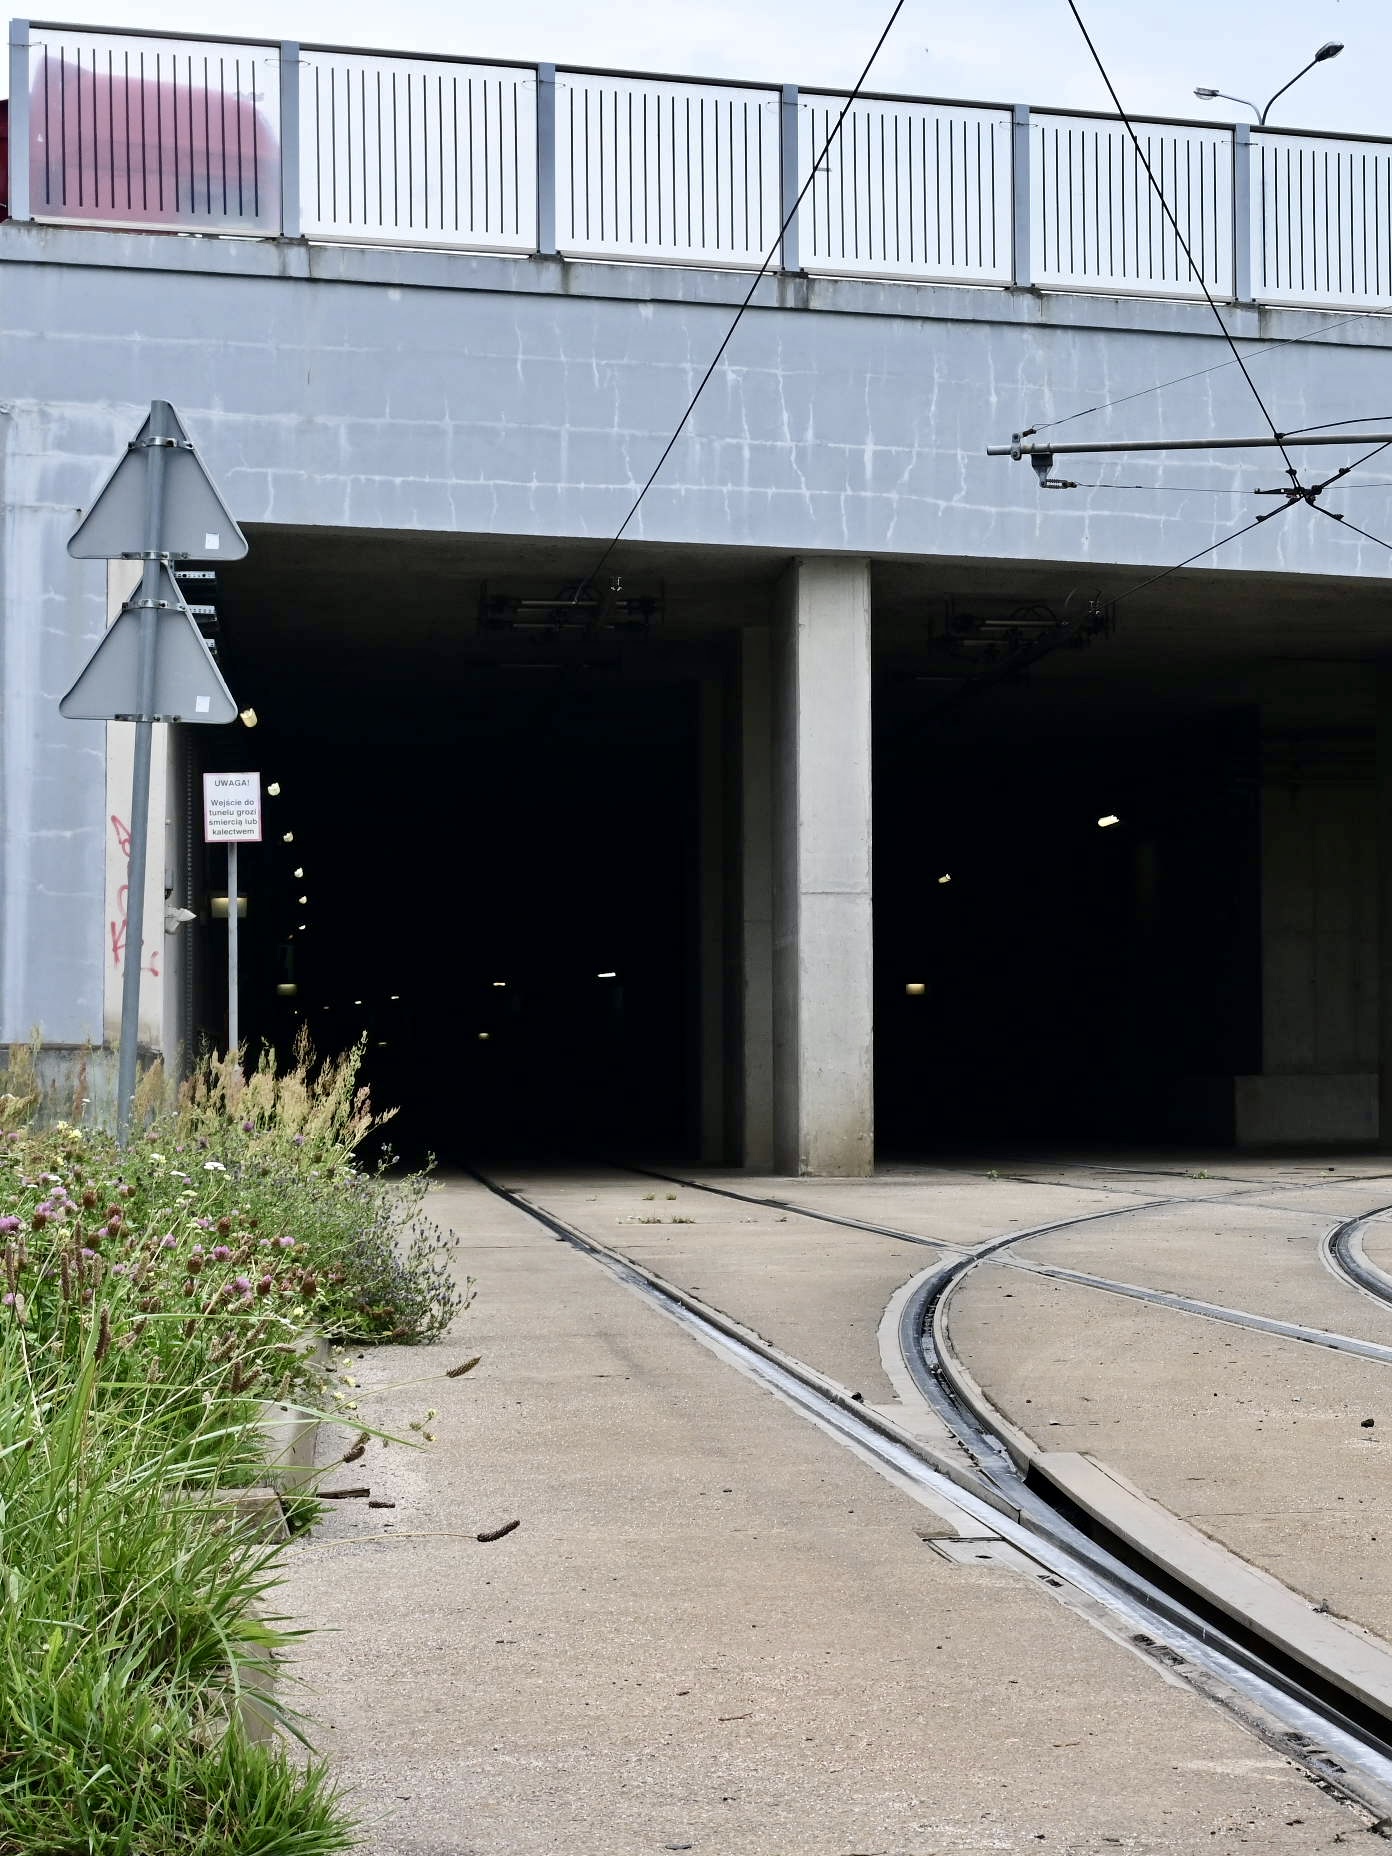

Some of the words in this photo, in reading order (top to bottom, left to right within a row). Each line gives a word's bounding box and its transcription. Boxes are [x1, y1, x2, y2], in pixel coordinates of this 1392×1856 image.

[214, 779, 250, 787] UWAGA!
[244, 798, 255, 806] do
[236, 808, 257, 817] grozi
[212, 828, 255, 836] kalectwem
